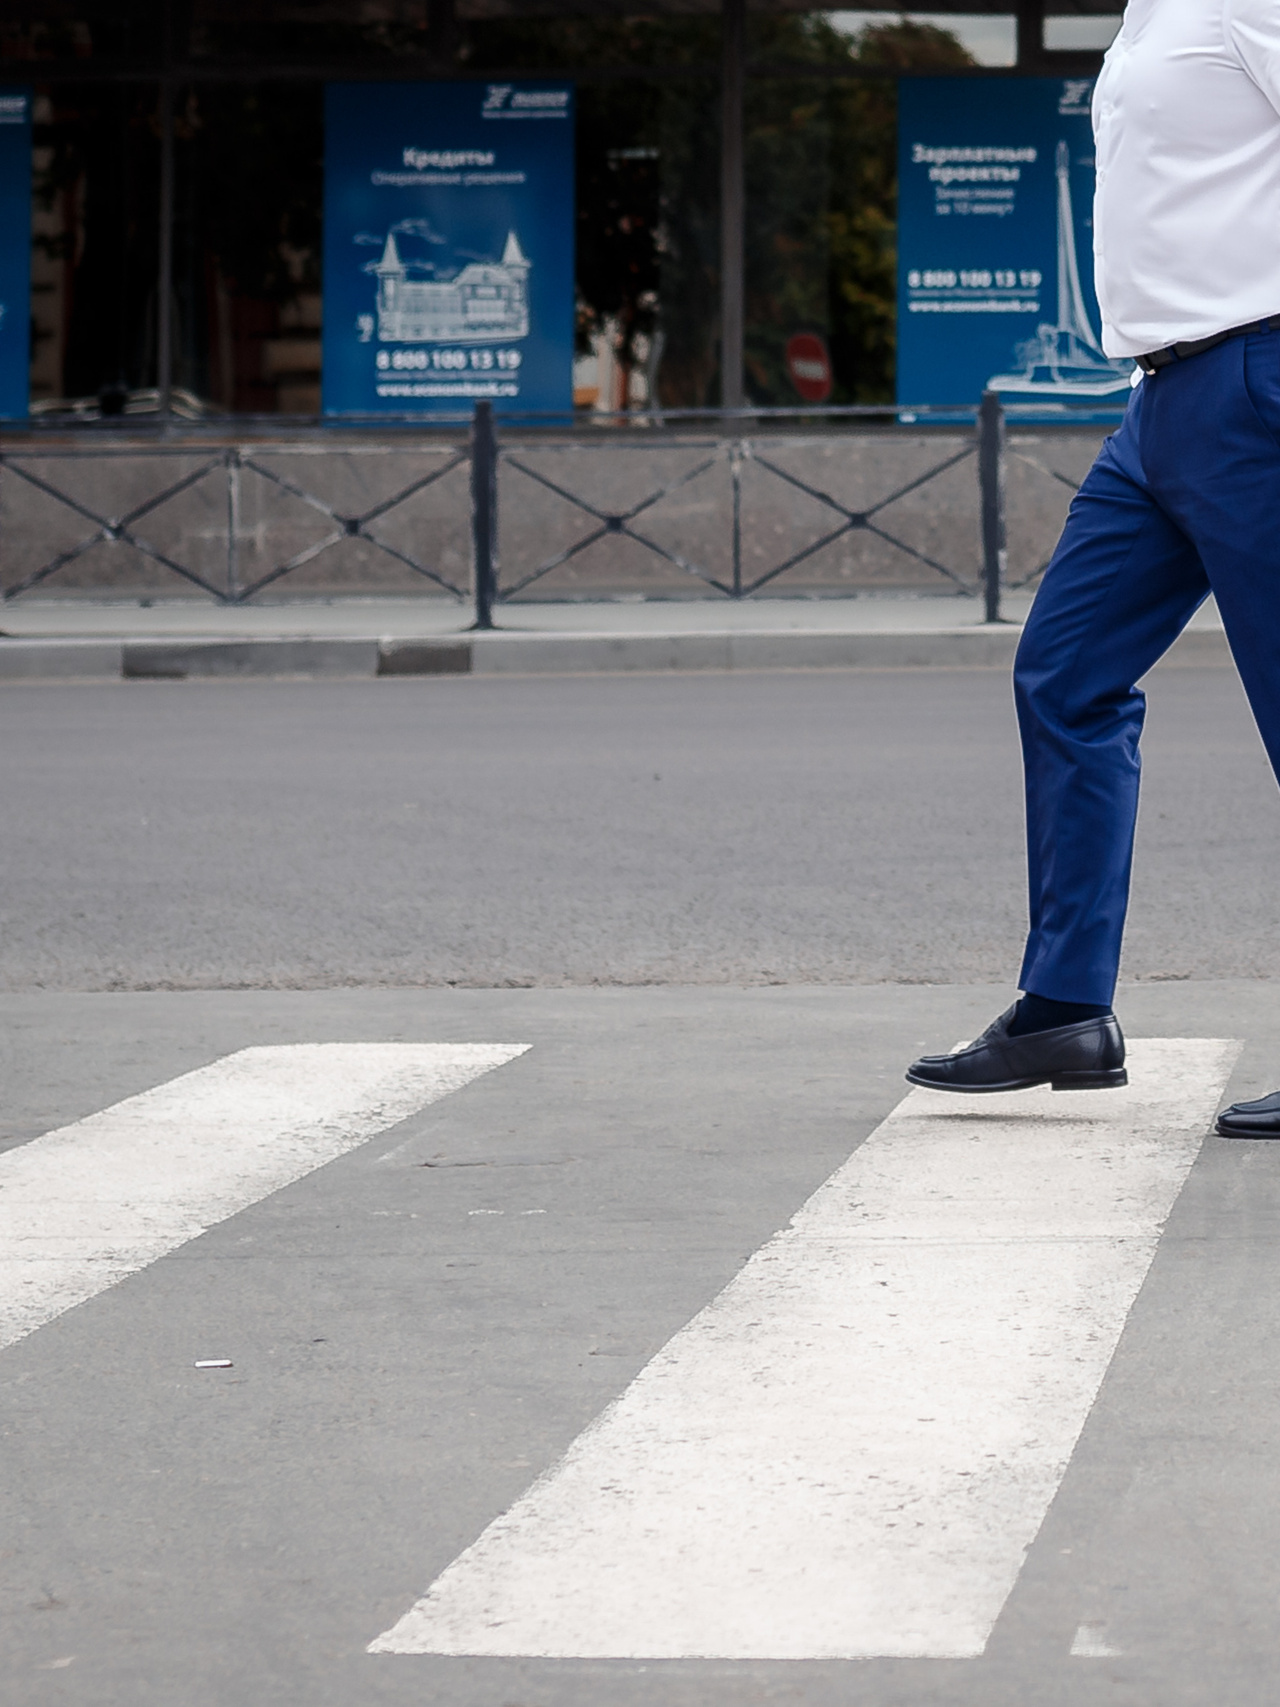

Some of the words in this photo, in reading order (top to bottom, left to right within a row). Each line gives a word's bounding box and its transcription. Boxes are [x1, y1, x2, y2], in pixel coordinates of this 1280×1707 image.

[403, 148, 495, 169] Кредиты
[912, 143, 1037, 165] Зарплатные
[928, 166, 1020, 184] проекты
[908, 269, 922, 288] 8
[922, 269, 957, 288] 800
[959, 269, 993, 288] 100
[995, 269, 1017, 288] 13
[1019, 269, 1042, 288] 19
[376, 350, 391, 370] 8
[391, 350, 430, 370] 800
[431, 350, 468, 370] 100
[470, 350, 495, 370] 13
[495, 350, 521, 370] 19
